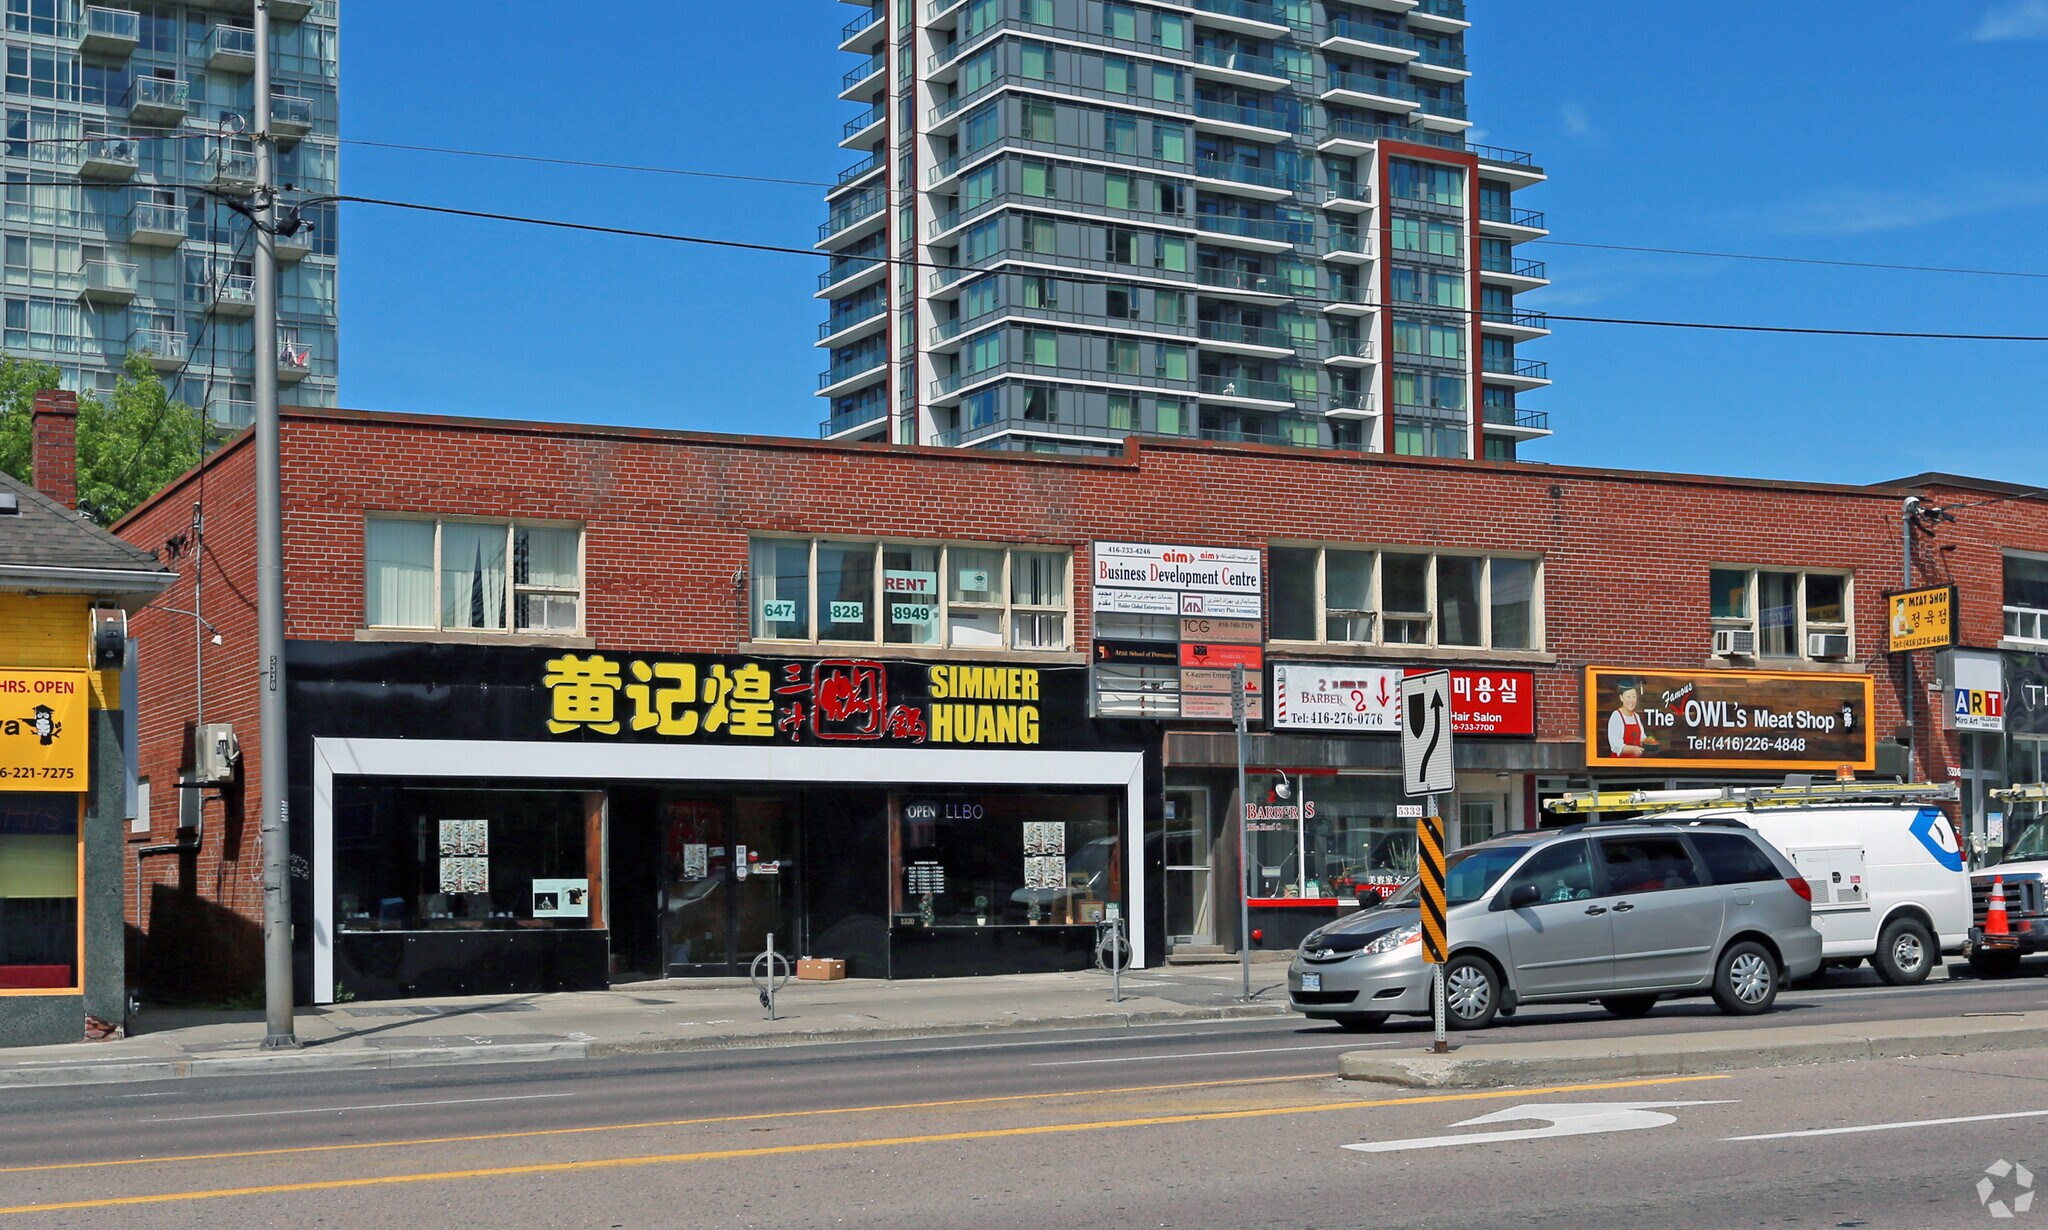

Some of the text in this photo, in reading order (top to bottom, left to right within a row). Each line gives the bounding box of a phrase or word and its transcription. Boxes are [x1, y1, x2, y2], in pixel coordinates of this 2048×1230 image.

[1108, 546, 1151, 555] 416-733-4246
[1163, 549, 1188, 564] aim
[1100, 561, 1257, 588] Business Development Centre
[885, 578, 928, 592] RENT
[1908, 592, 1948, 607] MEAT SHOP
[1184, 620, 1210, 633] TCG
[34, 680, 74, 694] OPEN
[930, 665, 1039, 700] SIMMER
[1453, 676, 1518, 704] 미용실
[544, 654, 775, 736] 黄记煌
[1301, 692, 1343, 704] BARBER
[1662, 682, 1694, 708] Famous
[1955, 690, 1999, 714] ART
[931, 704, 1039, 744] HUANG
[1291, 712, 1383, 726] Tel: 416-276-0776
[1450, 712, 1502, 723] Hair Salon
[1644, 700, 1835, 734] The OWL's Meat Shop
[1969, 717, 1978, 725] Art
[1687, 736, 1806, 753] Tel:(416)226-4848
[908, 805, 936, 818] OPEN
[1398, 806, 1421, 816] 5332
